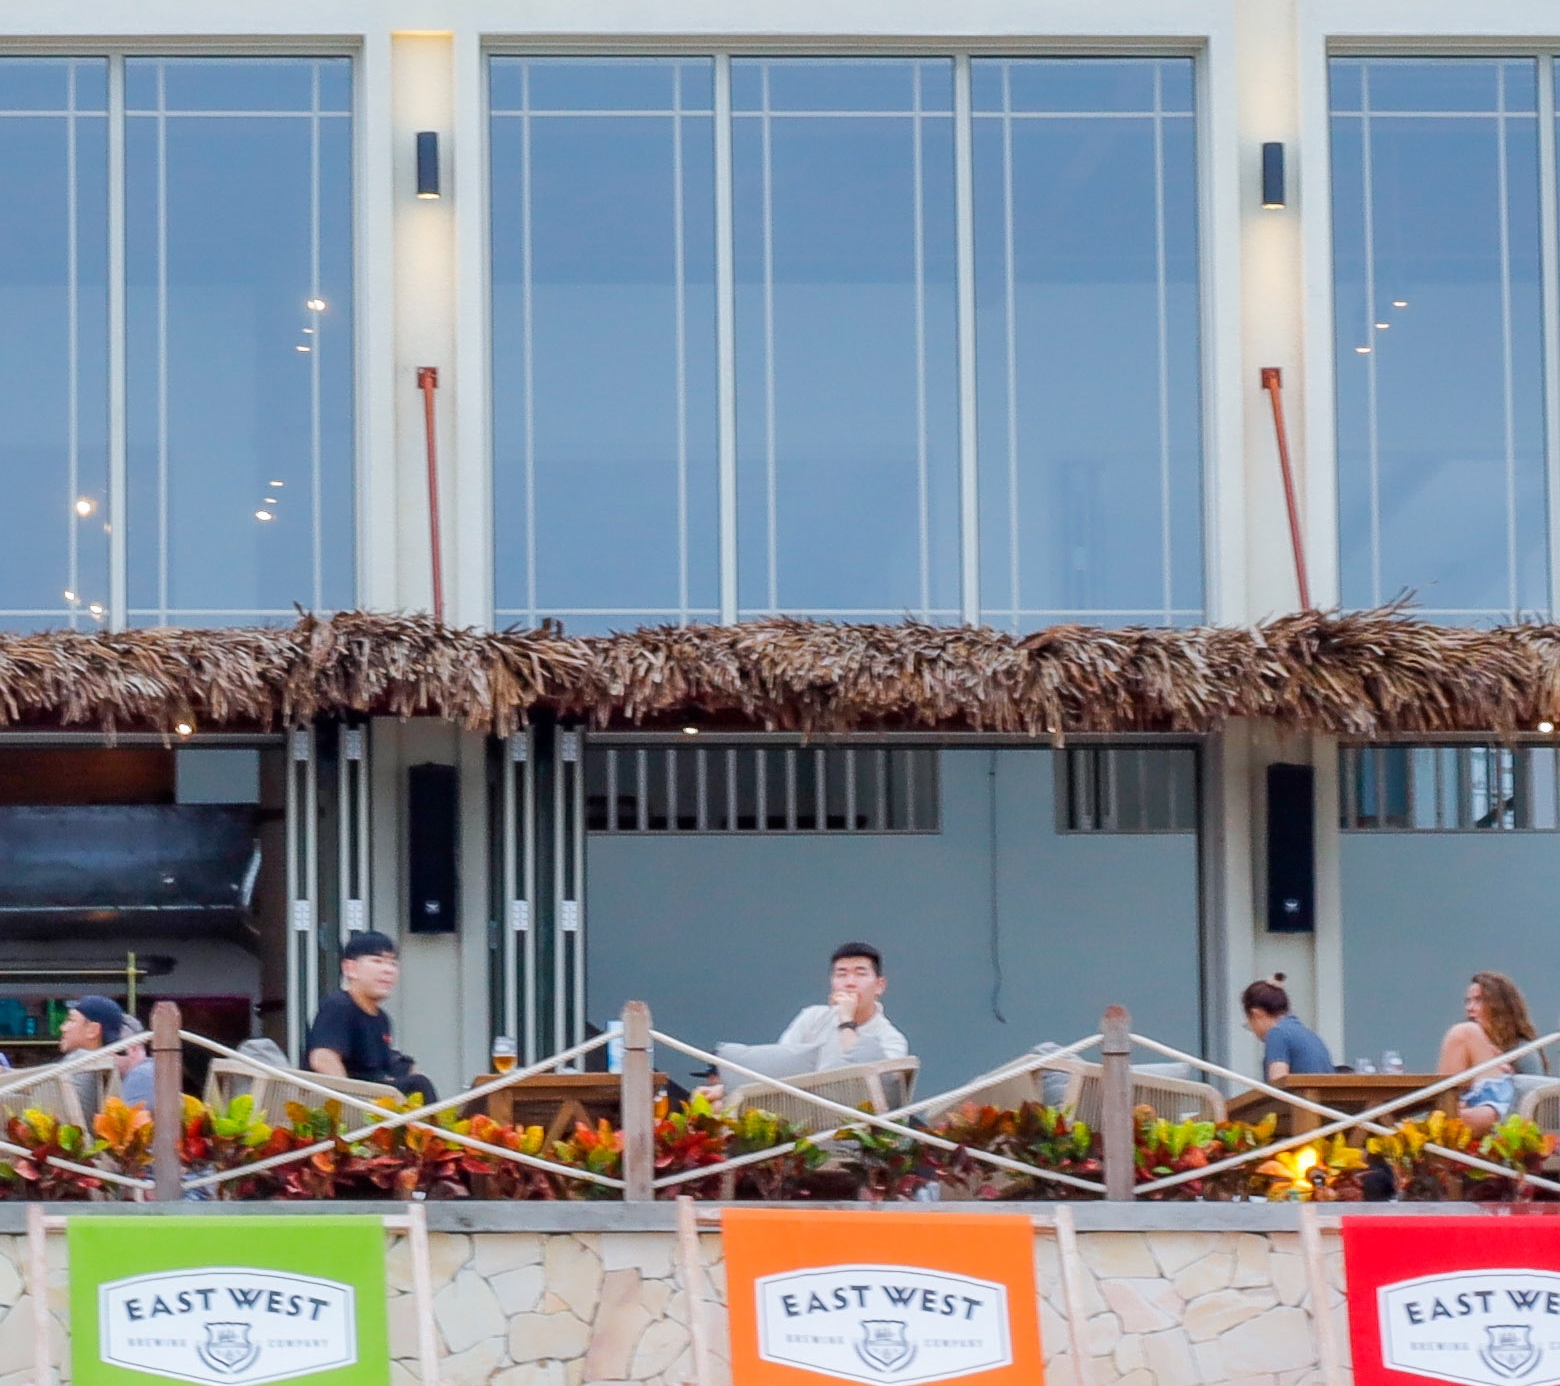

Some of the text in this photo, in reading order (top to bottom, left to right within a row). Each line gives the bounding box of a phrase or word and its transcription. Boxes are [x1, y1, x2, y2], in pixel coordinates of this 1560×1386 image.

[125, 1286, 331, 1322] EAST WEST
[781, 1284, 984, 1321] EAST WEST
[1404, 1290, 1495, 1326] EAST
